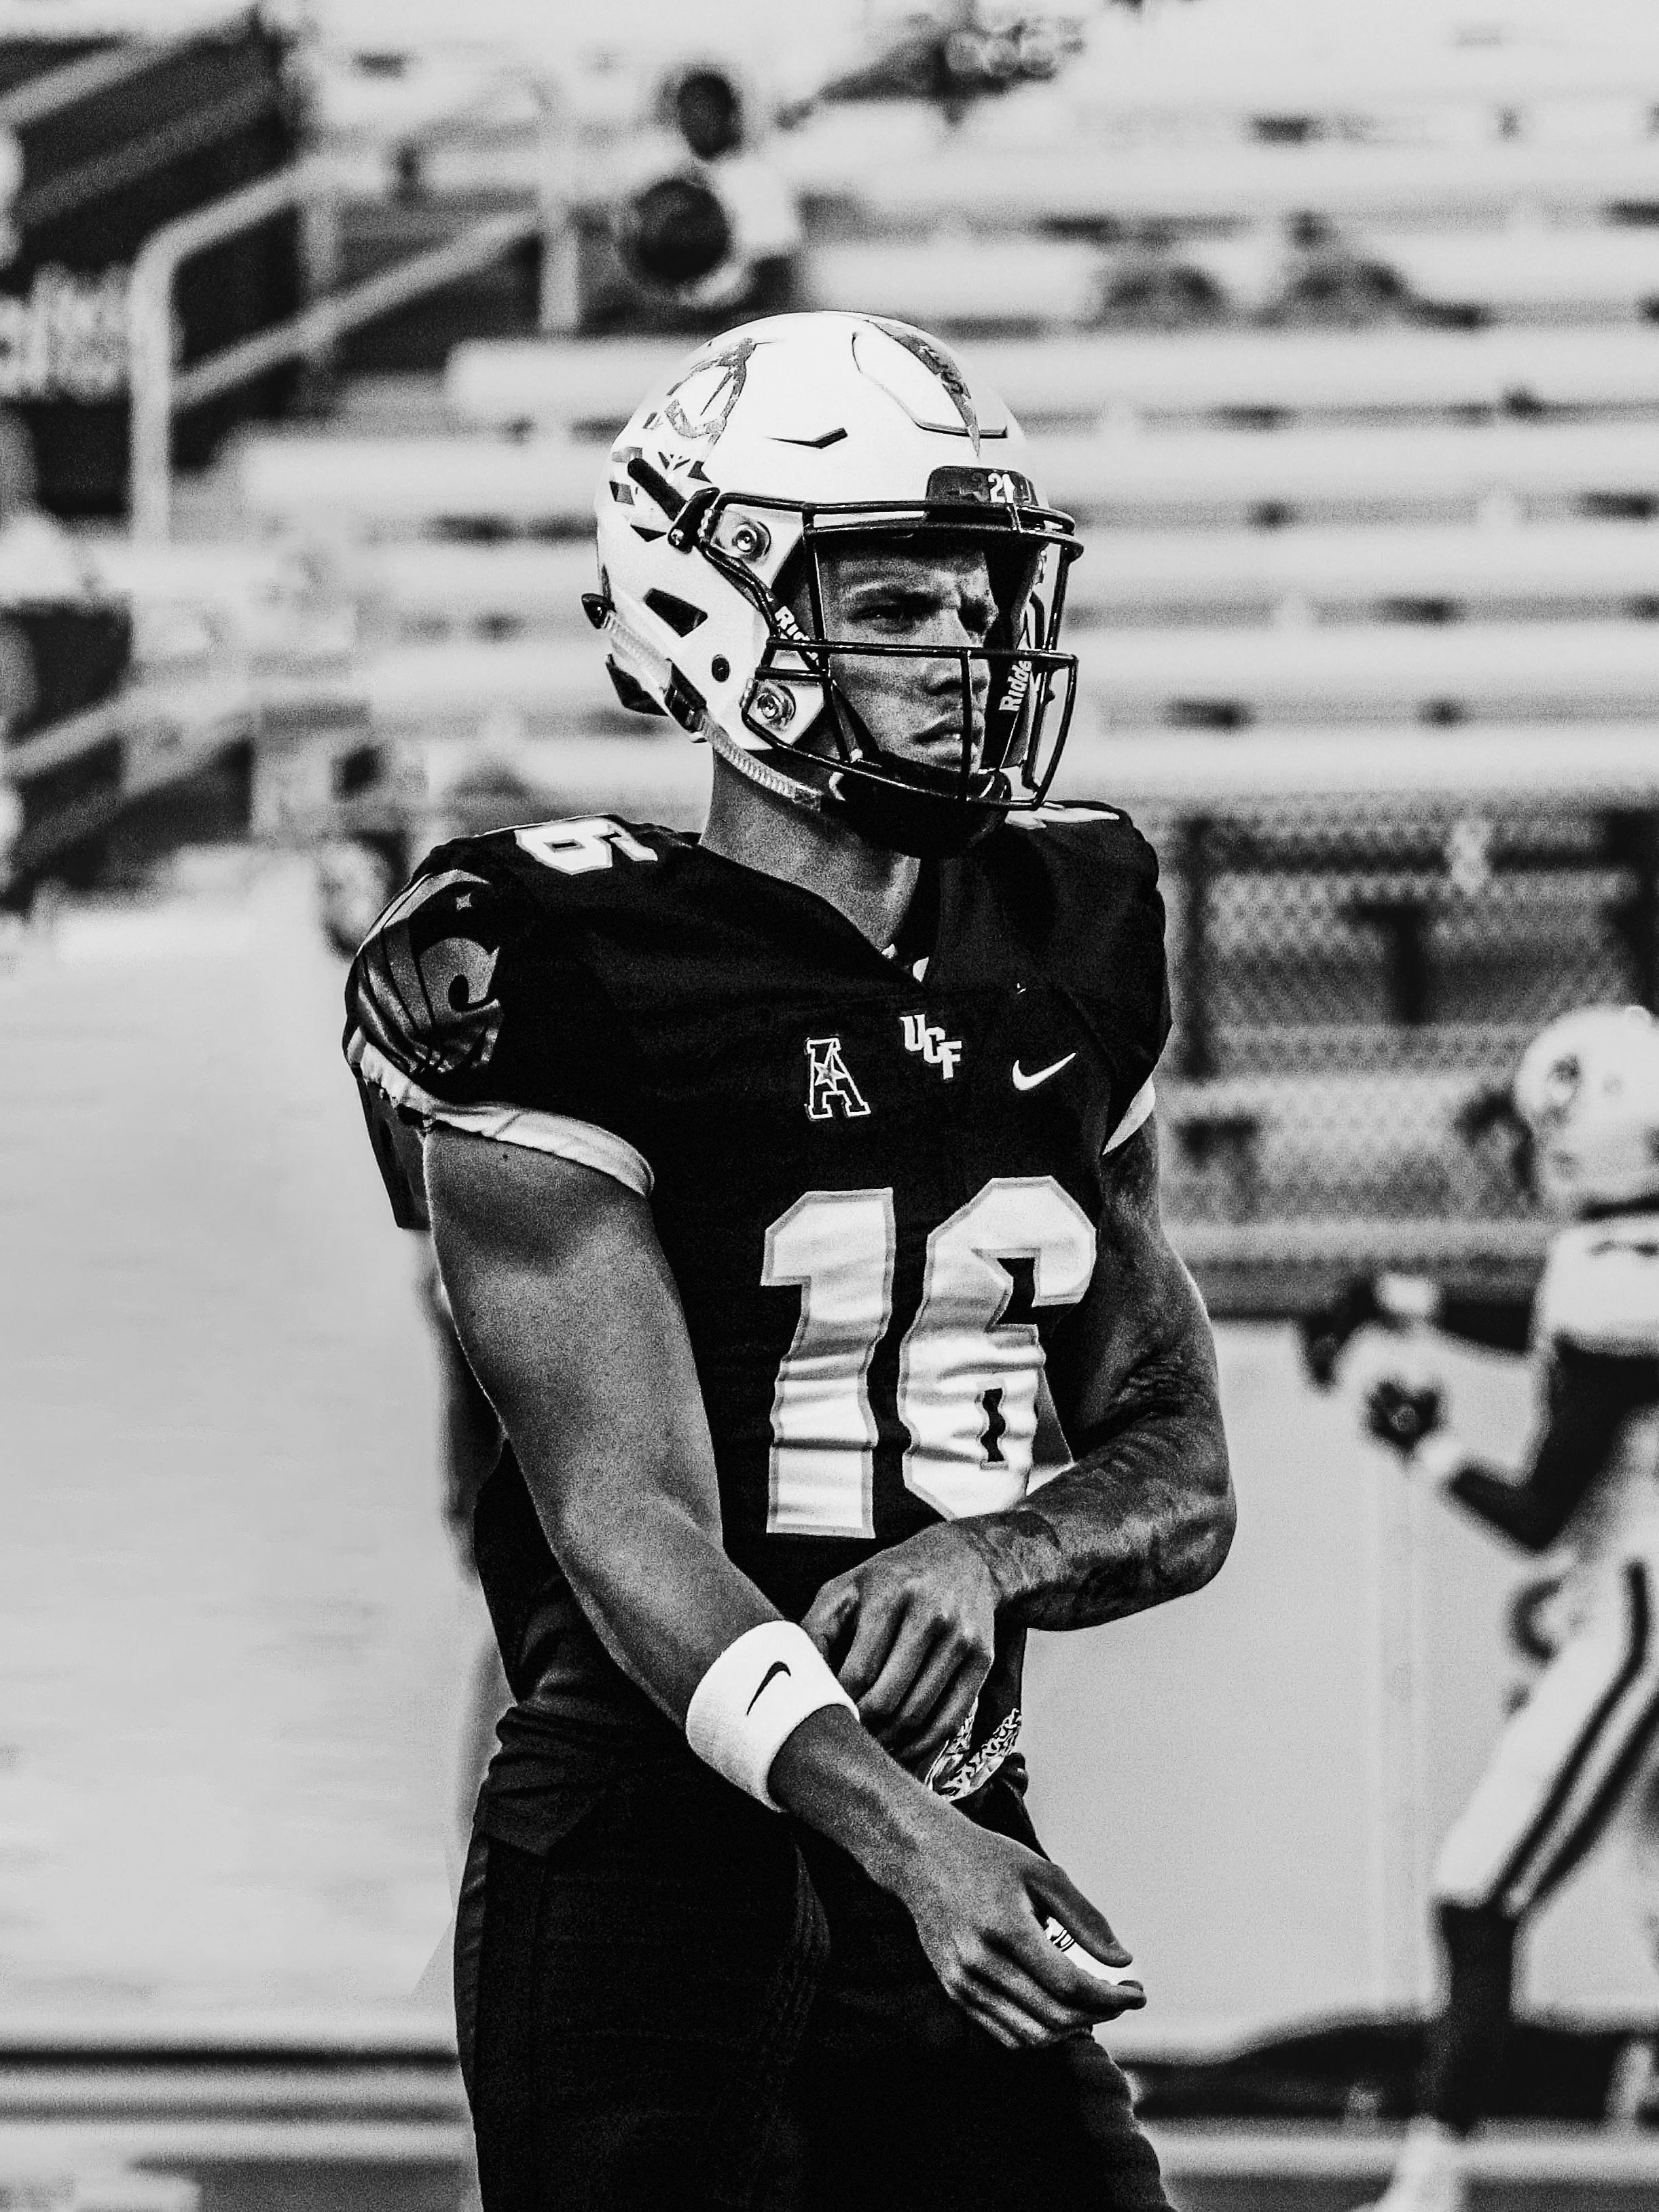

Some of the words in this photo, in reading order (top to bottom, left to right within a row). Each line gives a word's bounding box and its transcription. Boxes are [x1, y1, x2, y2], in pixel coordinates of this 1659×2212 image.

[998, 660, 1032, 712] Ridde
[900, 1014, 962, 1080] UCF
[760, 1175, 1097, 1539] 16
